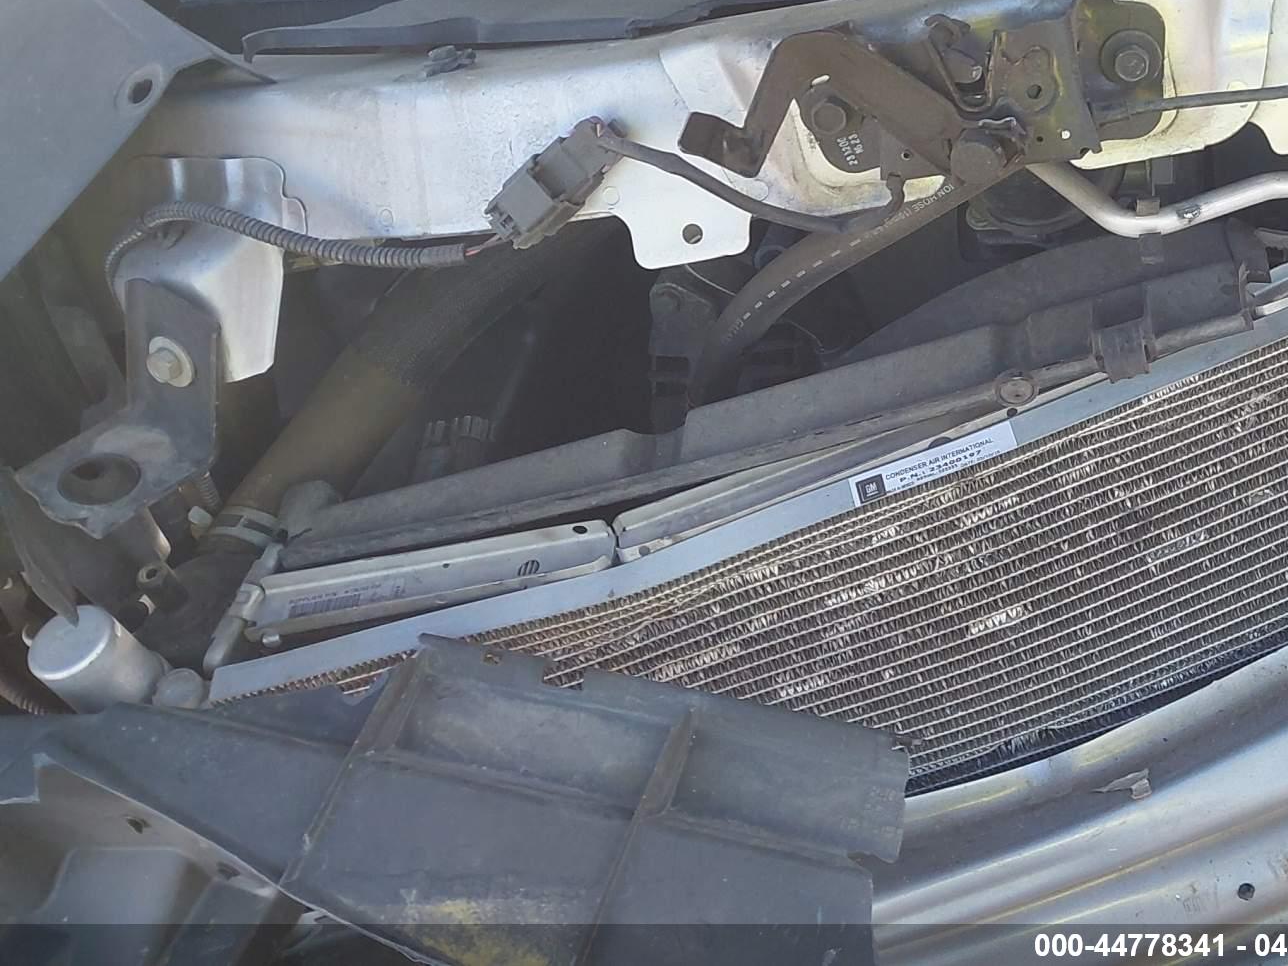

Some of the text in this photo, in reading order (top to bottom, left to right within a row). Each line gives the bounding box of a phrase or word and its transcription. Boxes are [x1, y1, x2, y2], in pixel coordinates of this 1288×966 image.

[885, 461, 928, 481] CONDENSER
[928, 456, 940, 467] AIR
[940, 437, 994, 462] INTERNATIONAL
